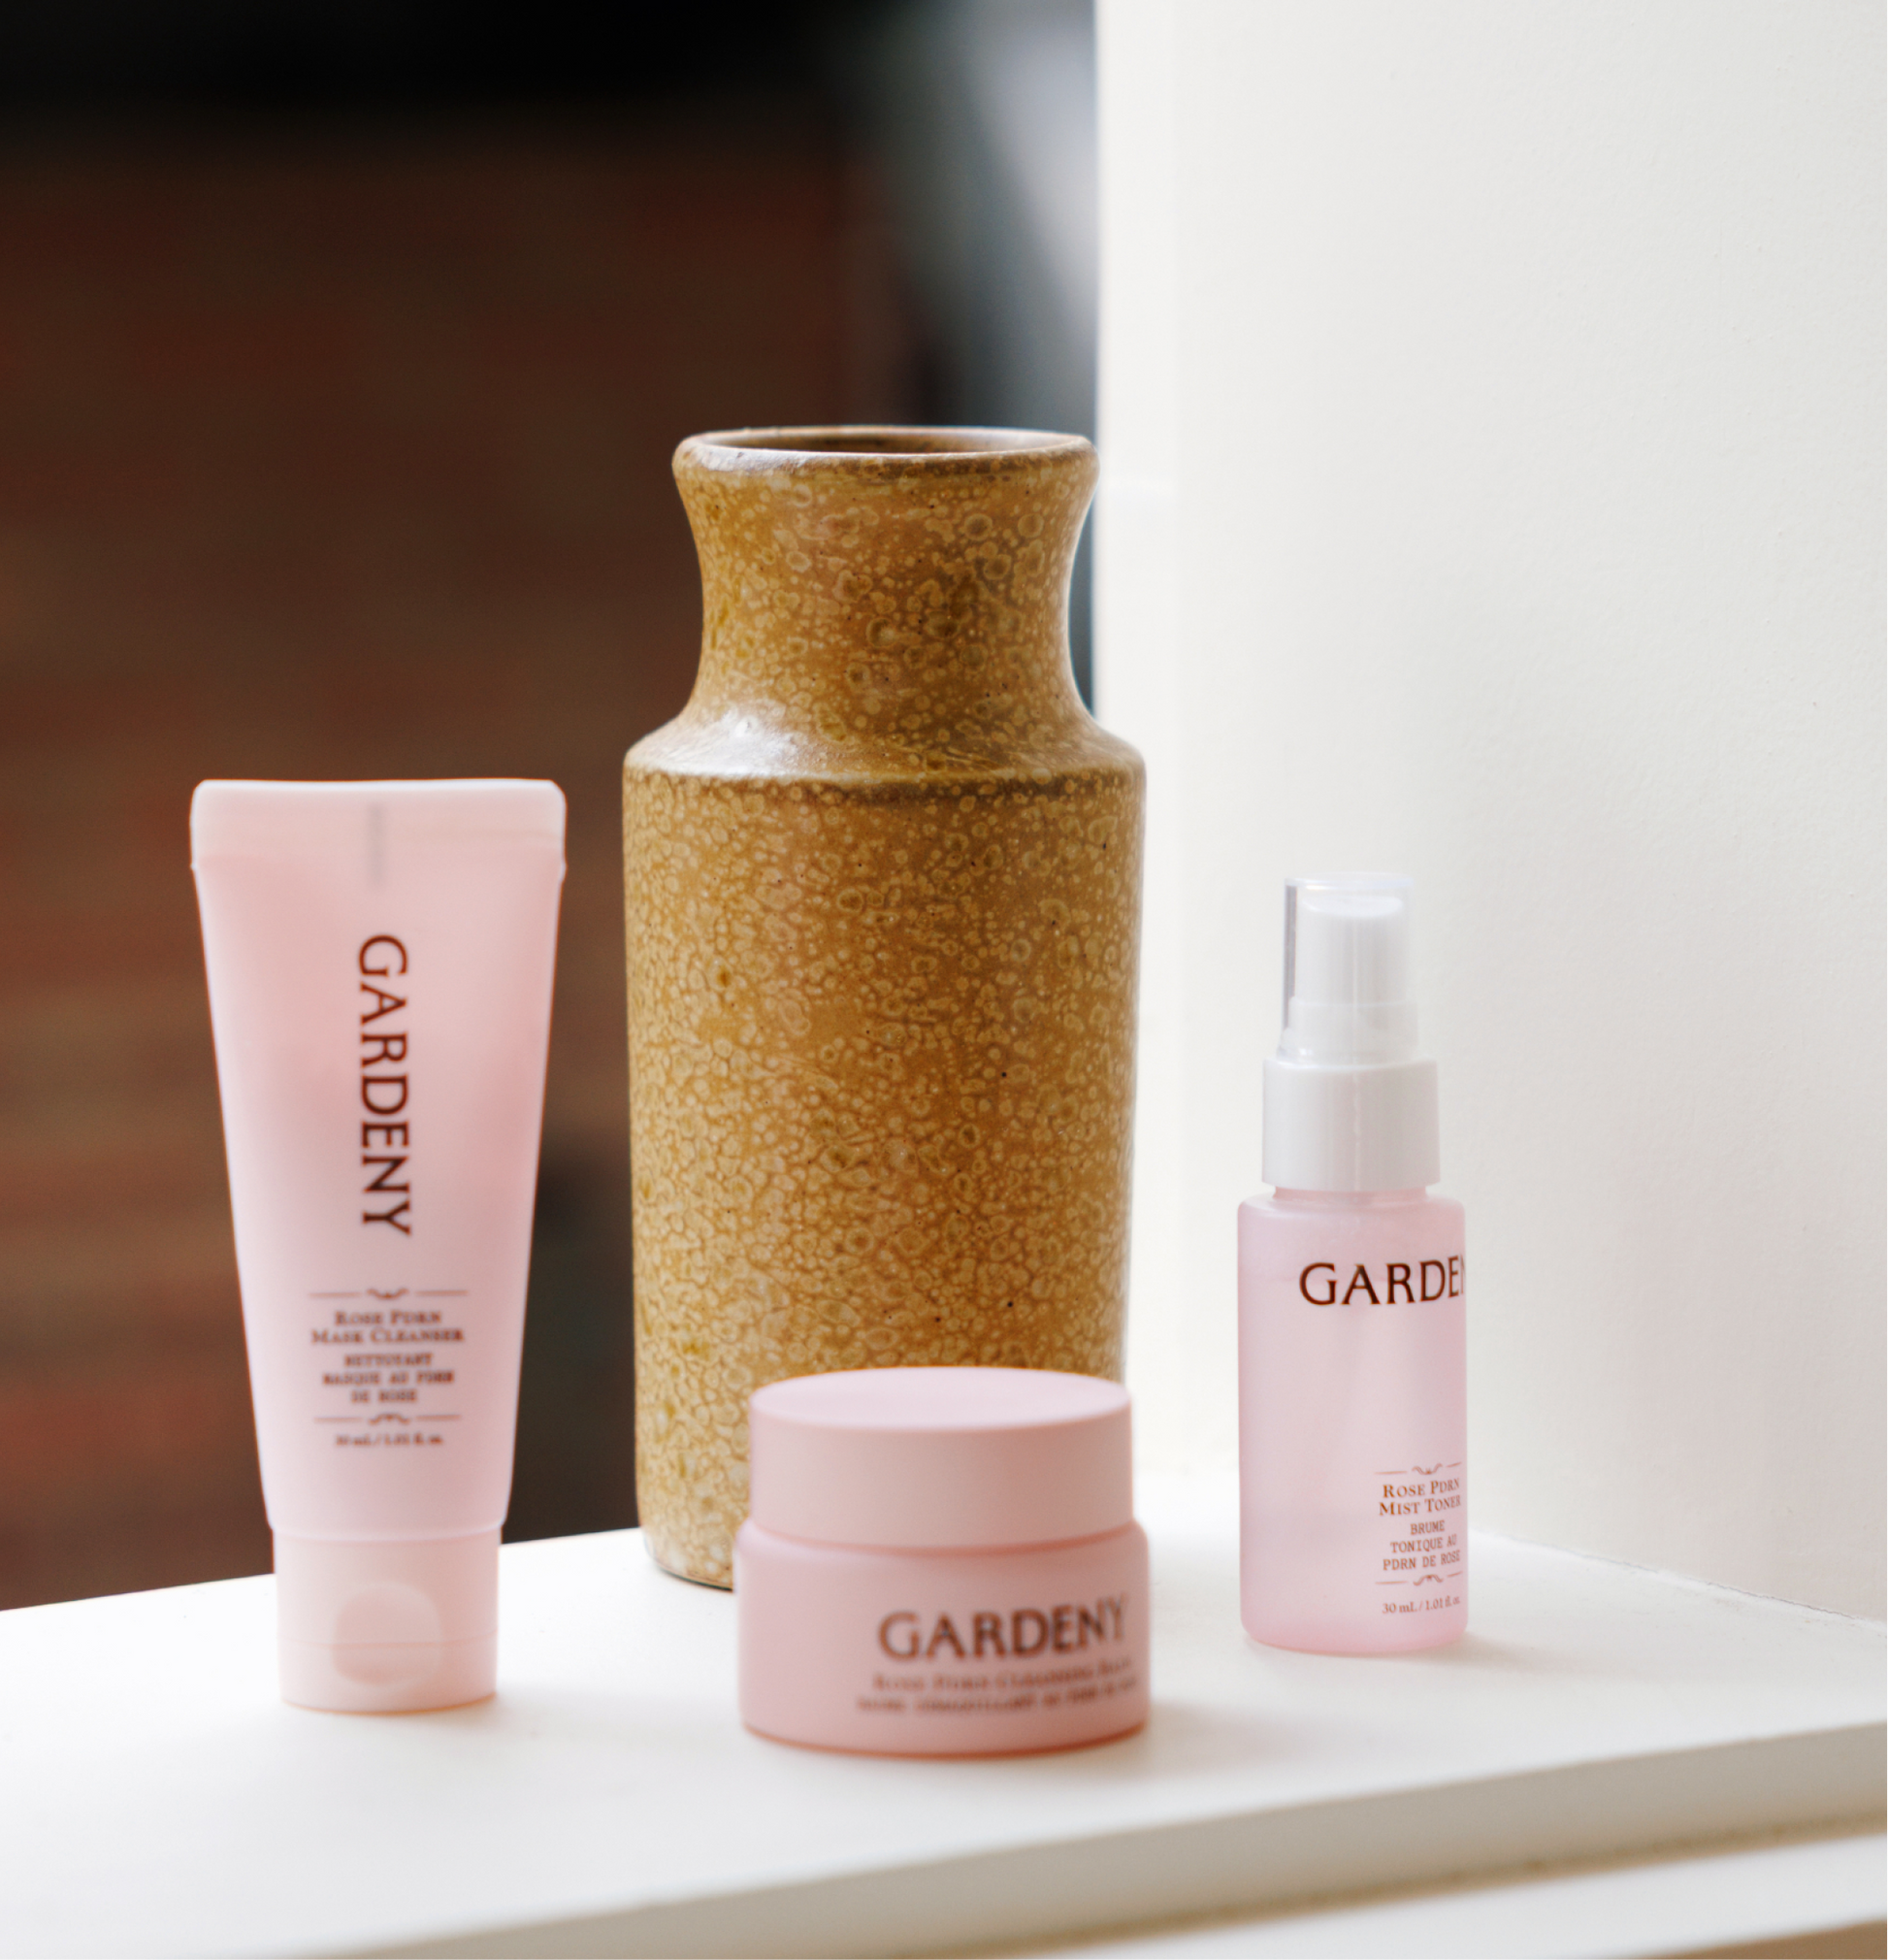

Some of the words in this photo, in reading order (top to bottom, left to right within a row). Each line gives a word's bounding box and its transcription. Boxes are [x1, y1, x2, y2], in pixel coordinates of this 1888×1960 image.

[358, 933, 412, 1237] GARDENY
[1383, 1483, 1425, 1498] ROSE
[1379, 1501, 1420, 1516] MIST
[1424, 1494, 1462, 1513] TONER
[1410, 1519, 1446, 1535] BRUME
[1390, 1536, 1444, 1553] TONIQUE
[1383, 1557, 1416, 1571] PDRN
[1422, 1554, 1437, 1568] DE
[1441, 1550, 1461, 1565] ROSE
[1382, 1602, 1397, 1615] 30
[877, 1591, 1127, 1662] GARDENY
